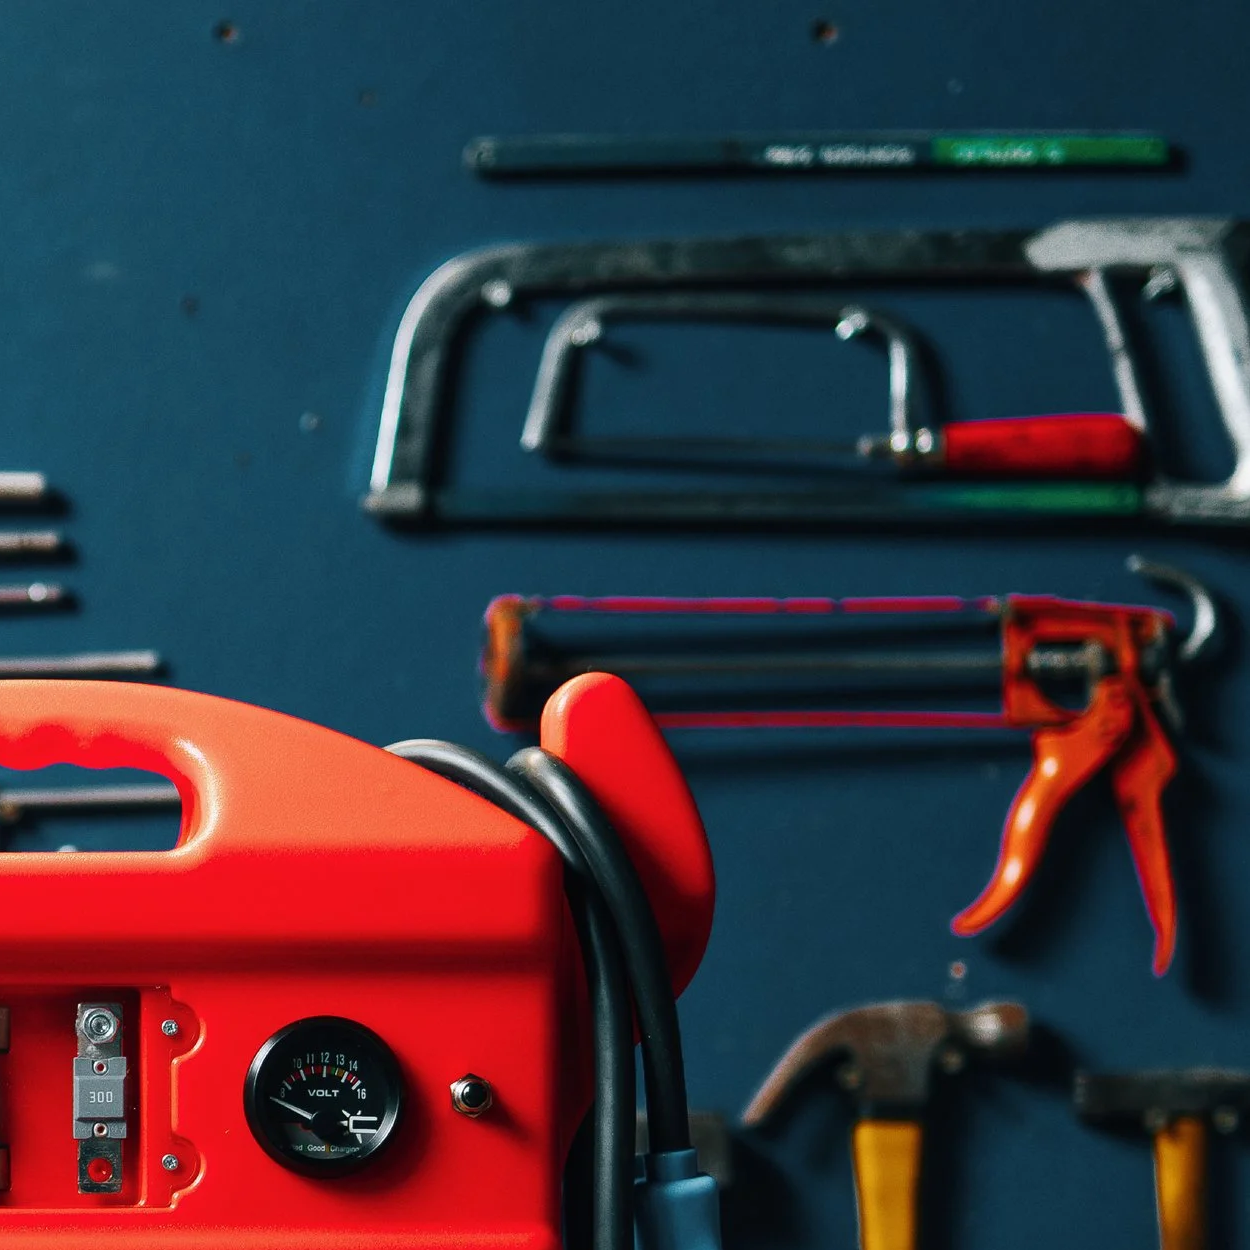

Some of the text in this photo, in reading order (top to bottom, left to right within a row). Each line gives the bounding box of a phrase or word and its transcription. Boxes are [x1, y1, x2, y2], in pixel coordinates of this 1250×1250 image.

[280, 1052, 367, 1100] 8 10 11 12 13 14 16
[89, 1091, 113, 1103] 300
[308, 1089, 340, 1098] VOLT
[307, 1144, 326, 1152] Good
